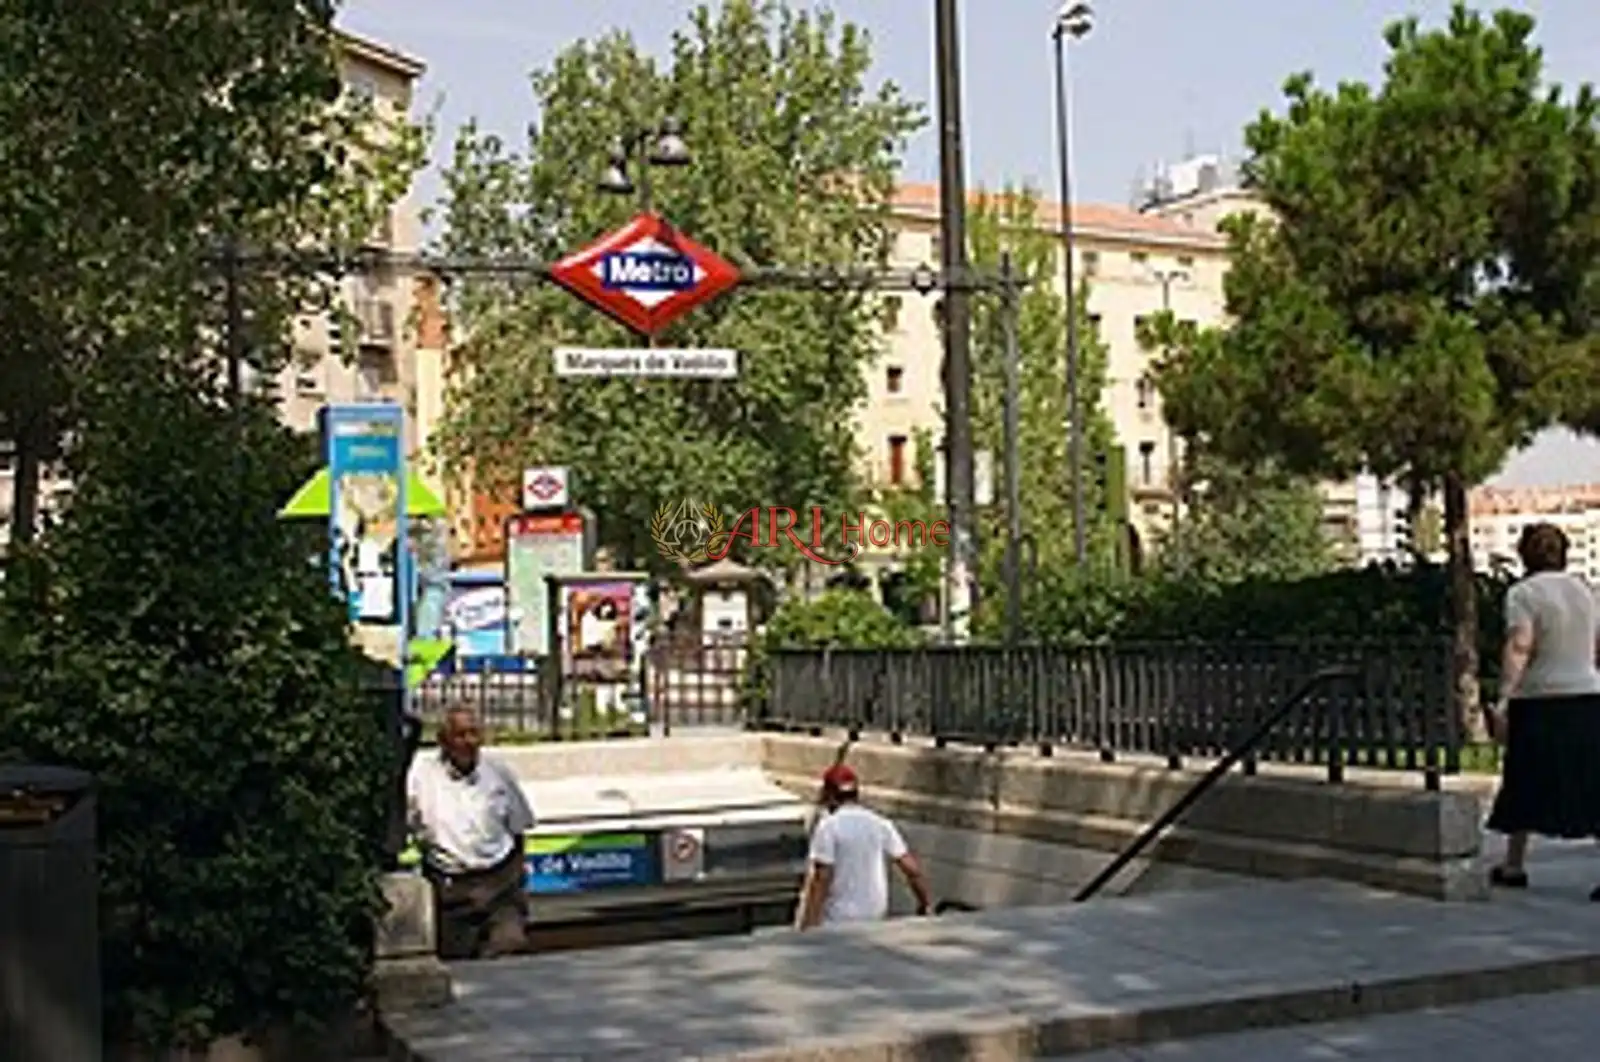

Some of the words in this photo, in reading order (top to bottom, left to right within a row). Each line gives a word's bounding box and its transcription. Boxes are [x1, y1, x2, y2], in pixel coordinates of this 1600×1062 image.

[609, 256, 690, 284] Metro
[645, 353, 666, 369] de
[541, 855, 564, 874] de
